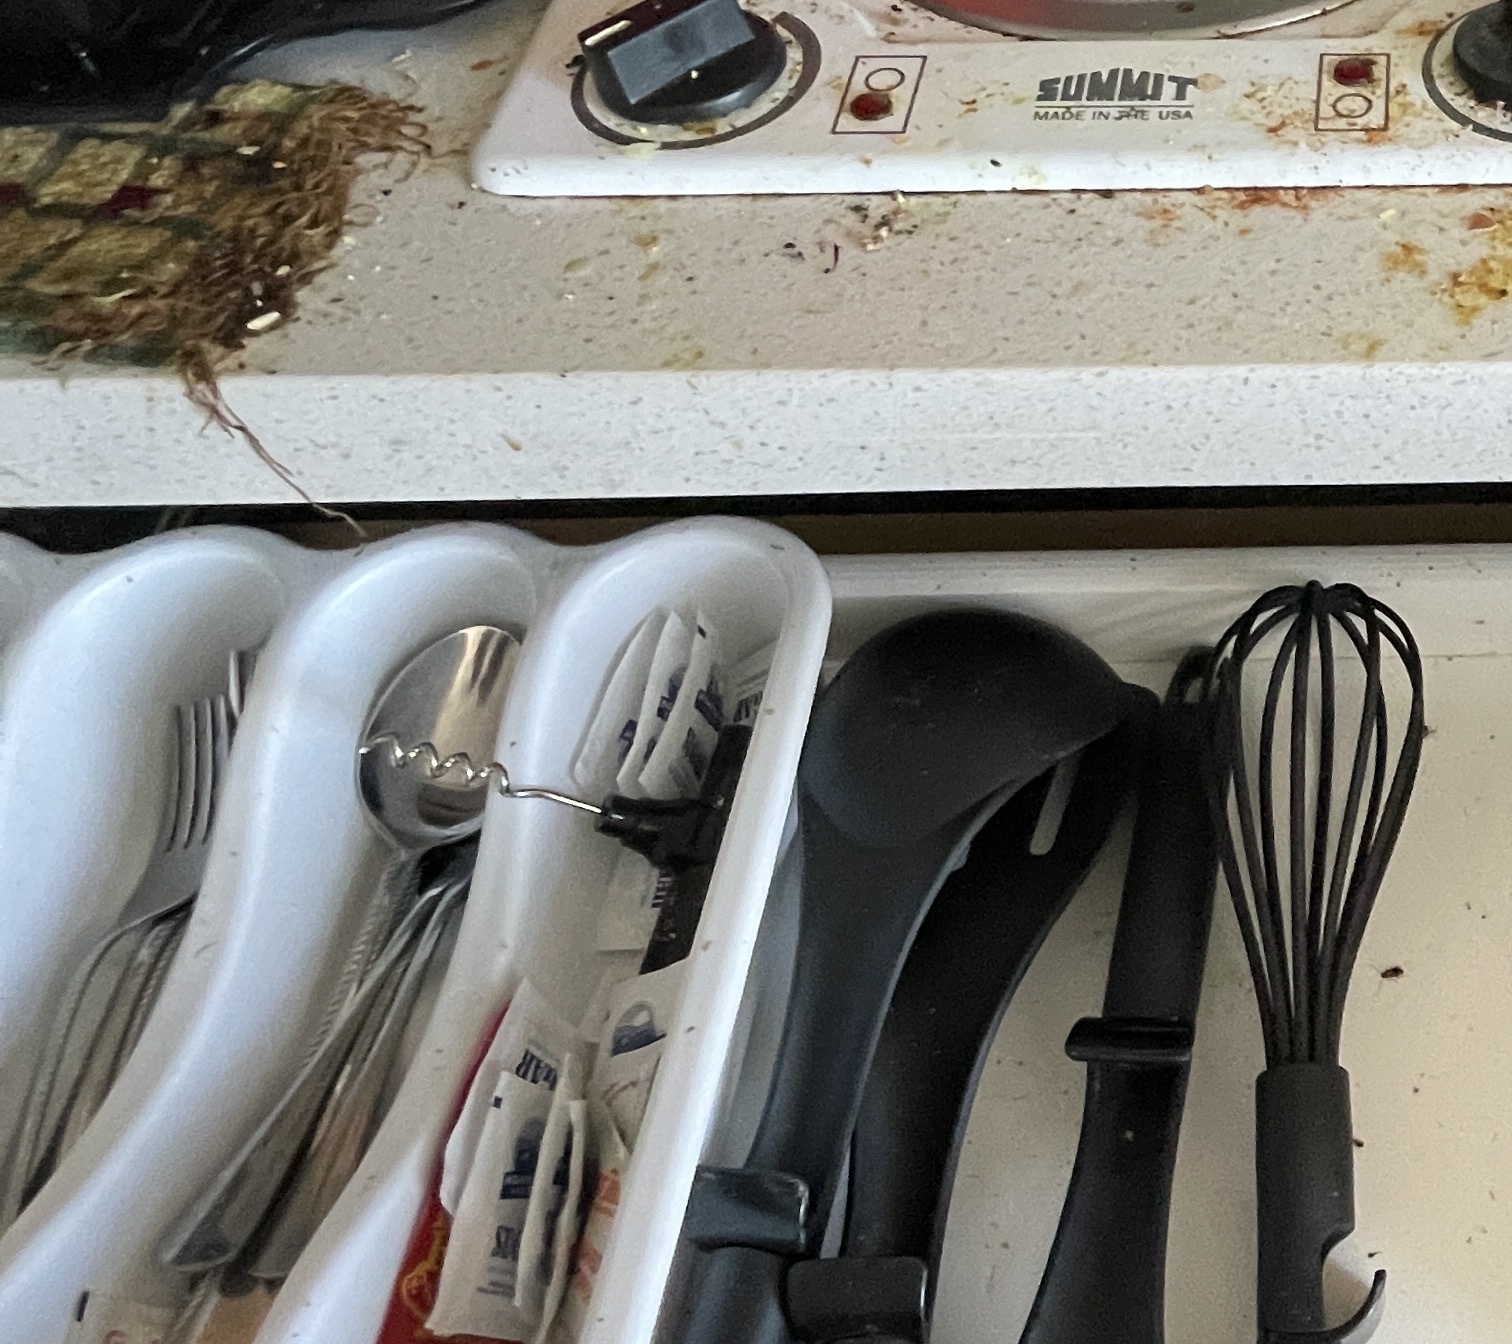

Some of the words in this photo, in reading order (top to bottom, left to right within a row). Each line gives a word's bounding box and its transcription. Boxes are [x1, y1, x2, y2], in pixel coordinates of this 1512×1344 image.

[1036, 67, 1199, 102] SUMMIT
[1033, 109, 1085, 122] MADE
[1091, 109, 1112, 122] IN
[1157, 109, 1194, 121] USA
